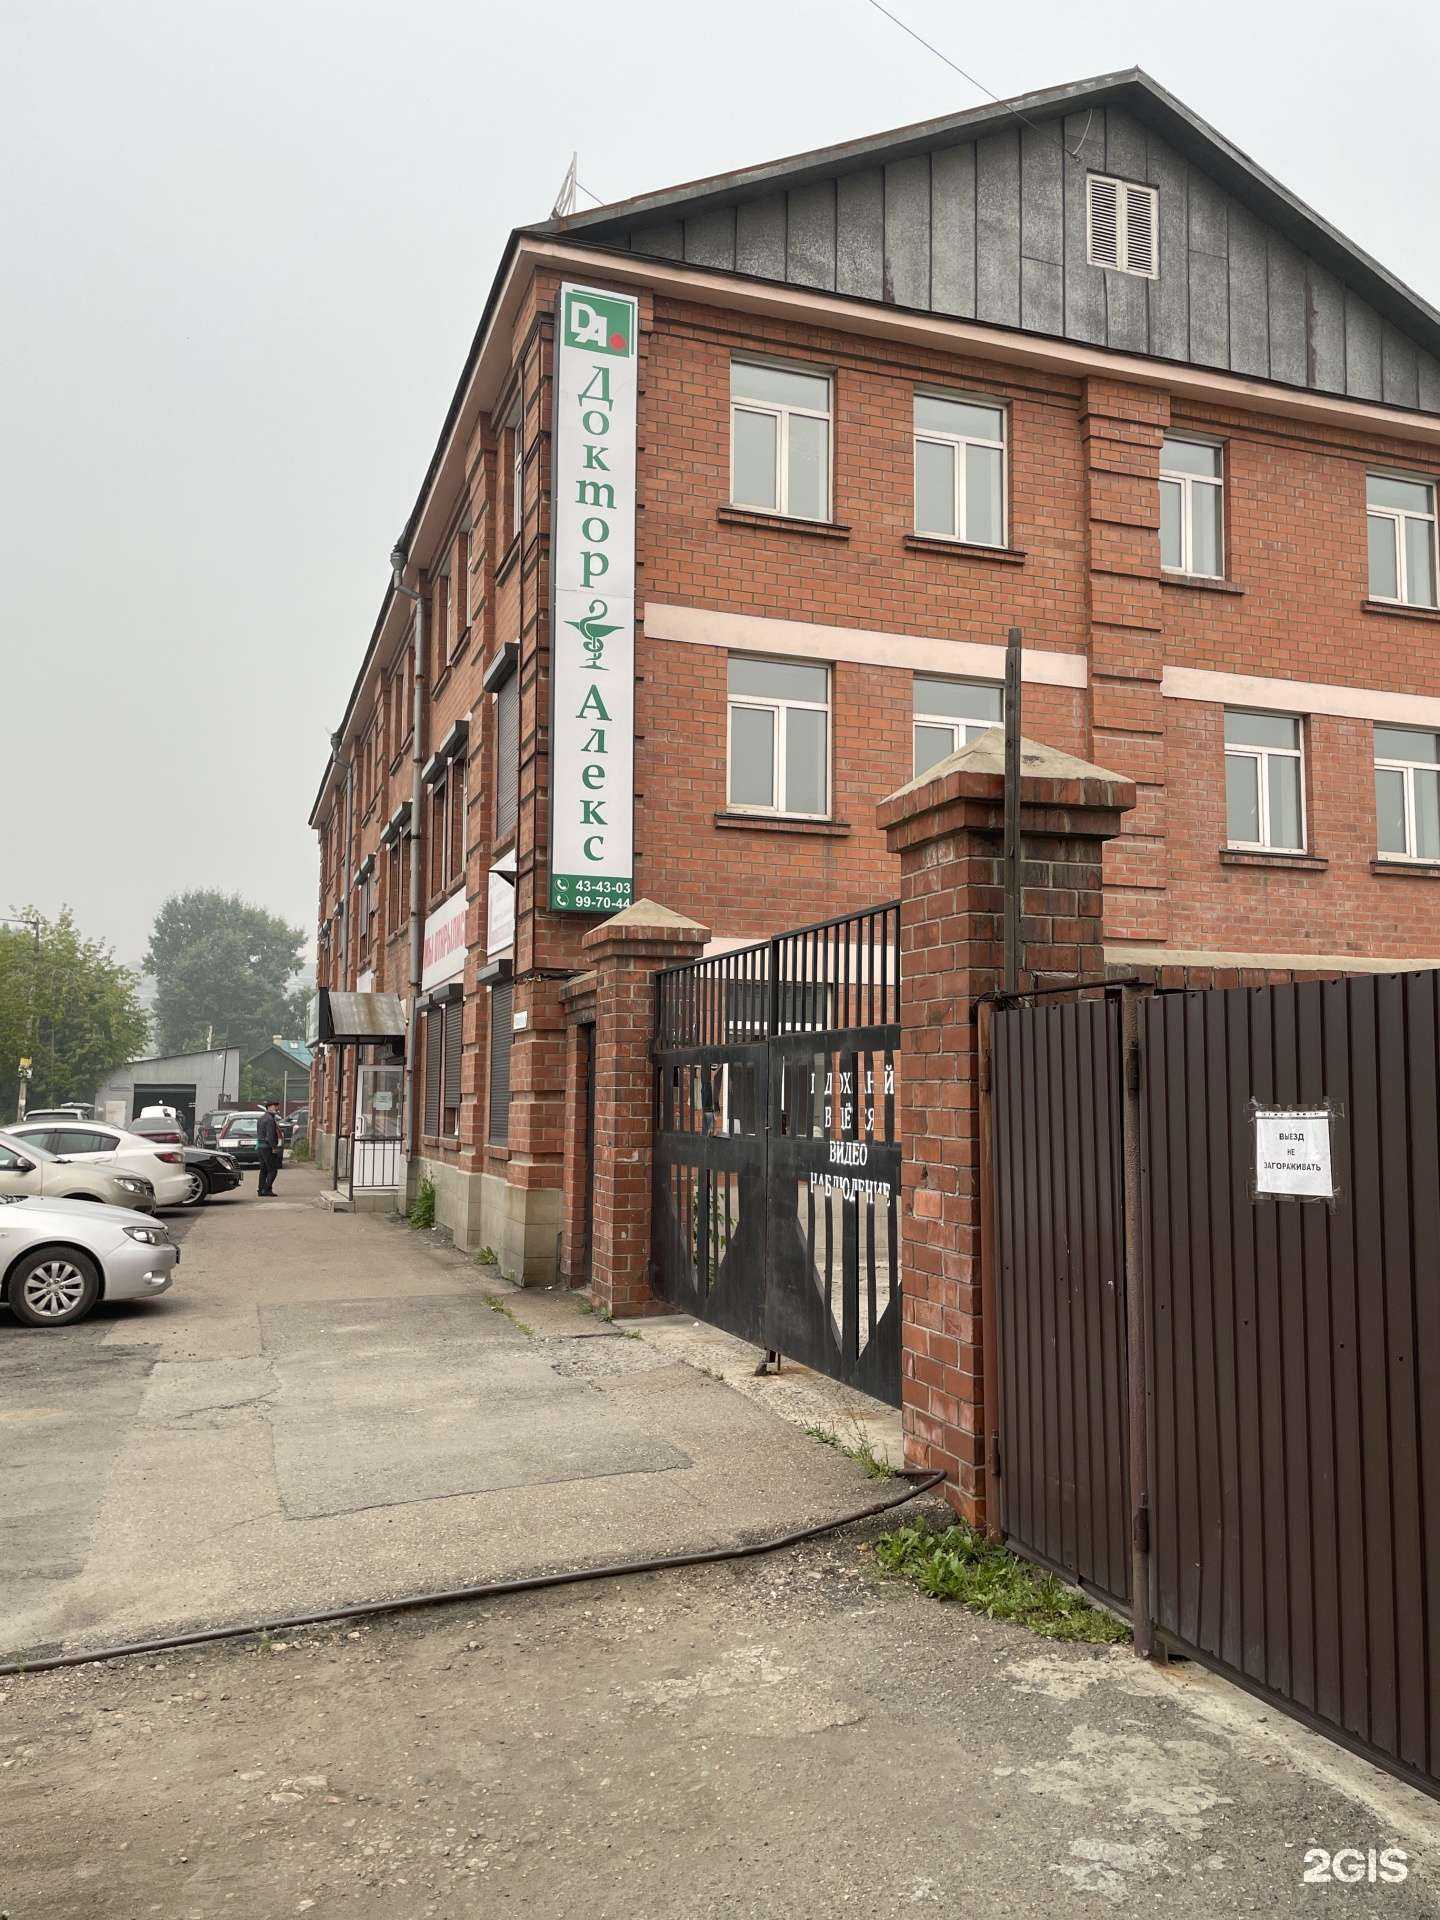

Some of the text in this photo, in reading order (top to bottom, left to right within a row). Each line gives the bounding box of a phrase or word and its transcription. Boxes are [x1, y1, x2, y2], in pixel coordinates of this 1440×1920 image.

[576, 365, 617, 588] Доктор
[576, 684, 612, 861] Алекс
[575, 880, 631, 893] 43-43-03
[575, 896, 630, 908] 99-70-44
[1279, 1133, 1305, 1142] ВЫЕЗД
[829, 1140, 868, 1166] ВИДЕО
[1287, 1148, 1296, 1156] НЕ
[1263, 1161, 1322, 1172] ЗАГОРАЖИВАТЬ
